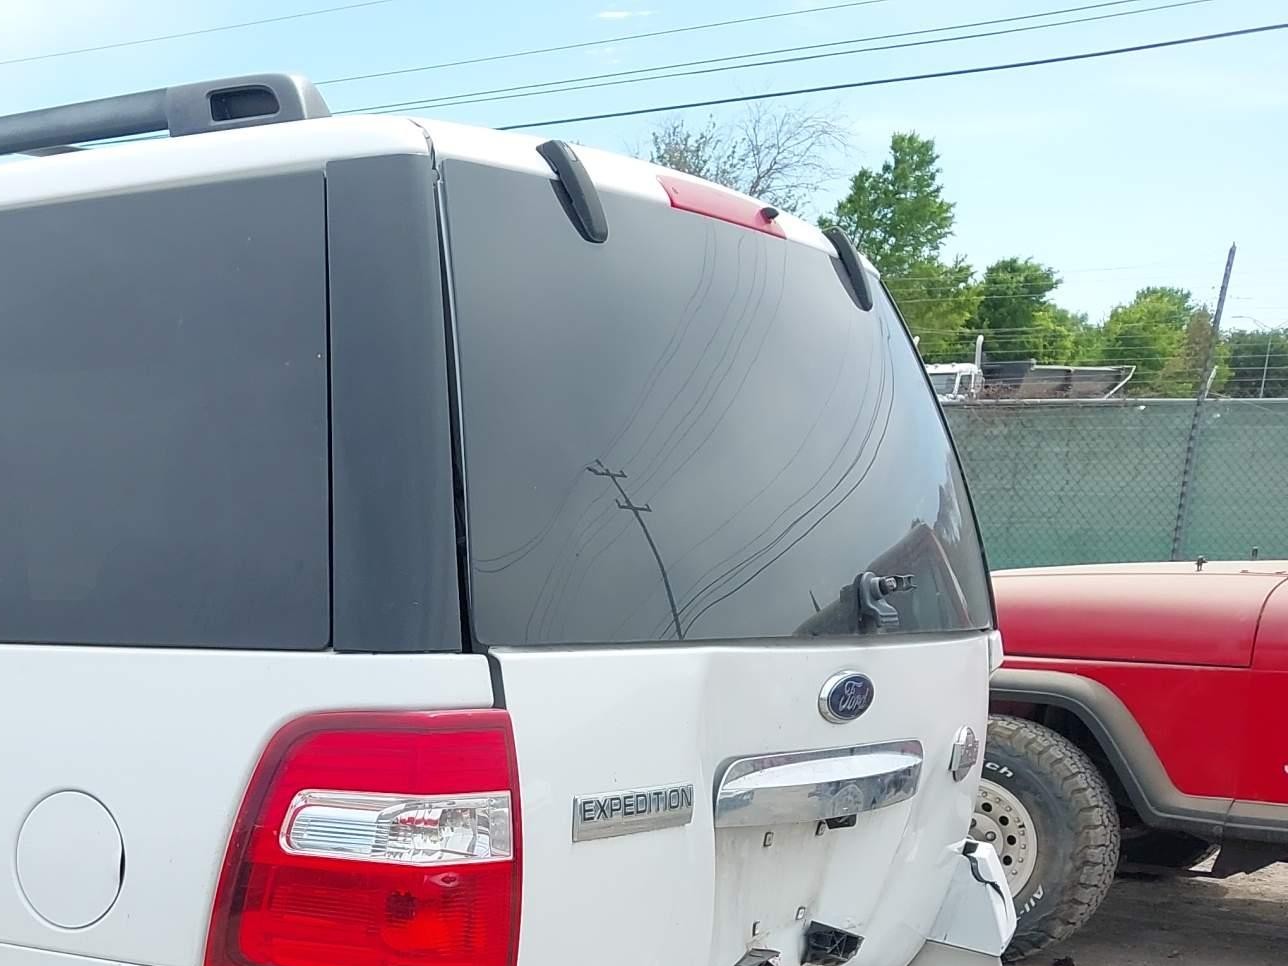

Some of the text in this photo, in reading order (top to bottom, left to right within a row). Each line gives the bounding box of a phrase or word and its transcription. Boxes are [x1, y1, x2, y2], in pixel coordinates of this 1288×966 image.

[838, 680, 869, 712] Ford
[985, 762, 1014, 778] ch
[581, 784, 694, 821] EXPEDITION
